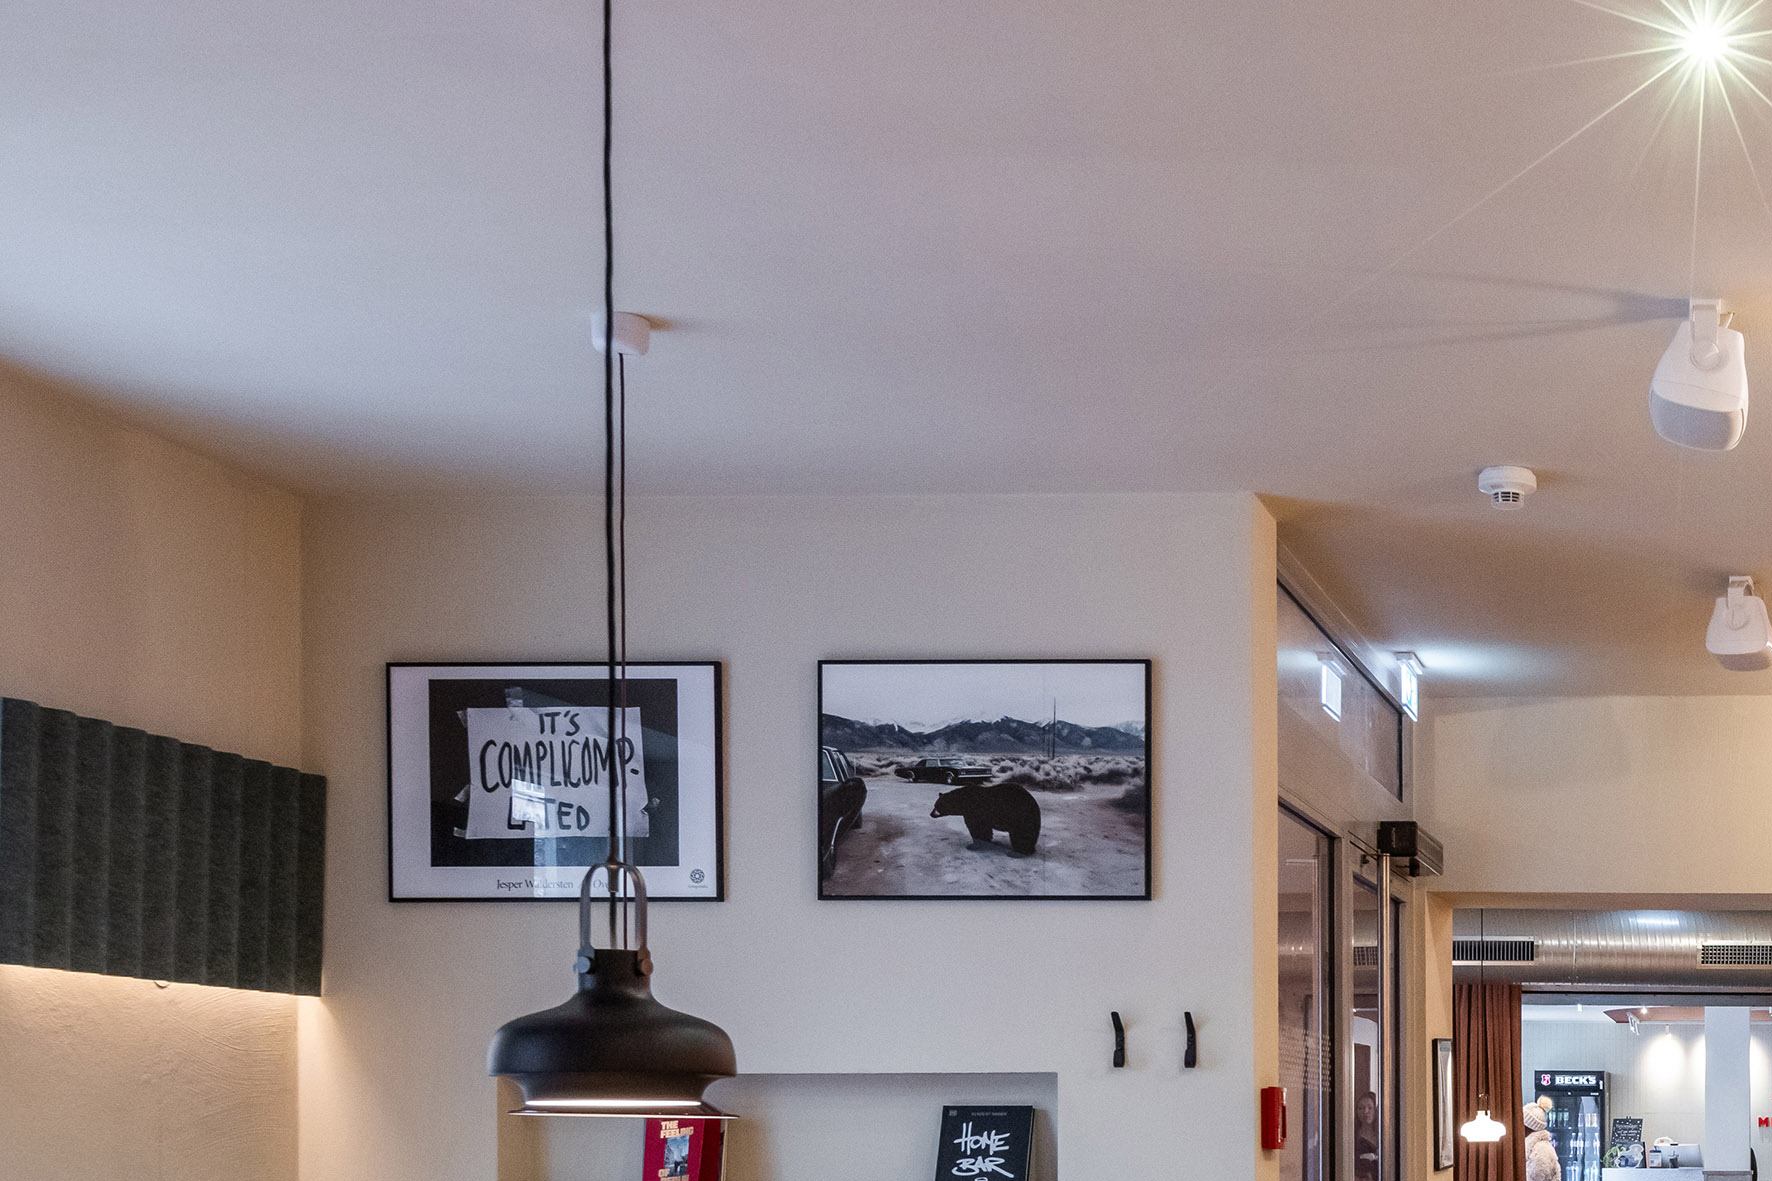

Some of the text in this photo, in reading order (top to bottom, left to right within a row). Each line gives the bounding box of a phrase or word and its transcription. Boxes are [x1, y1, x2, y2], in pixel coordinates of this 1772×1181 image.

[539, 710, 581, 736] IT'S
[496, 879, 523, 891] Jesper
[1555, 1075, 1597, 1085] BECK'S
[661, 1120, 679, 1130] THE
[953, 1121, 1011, 1155] HOME
[951, 1156, 1015, 1178] BAR
